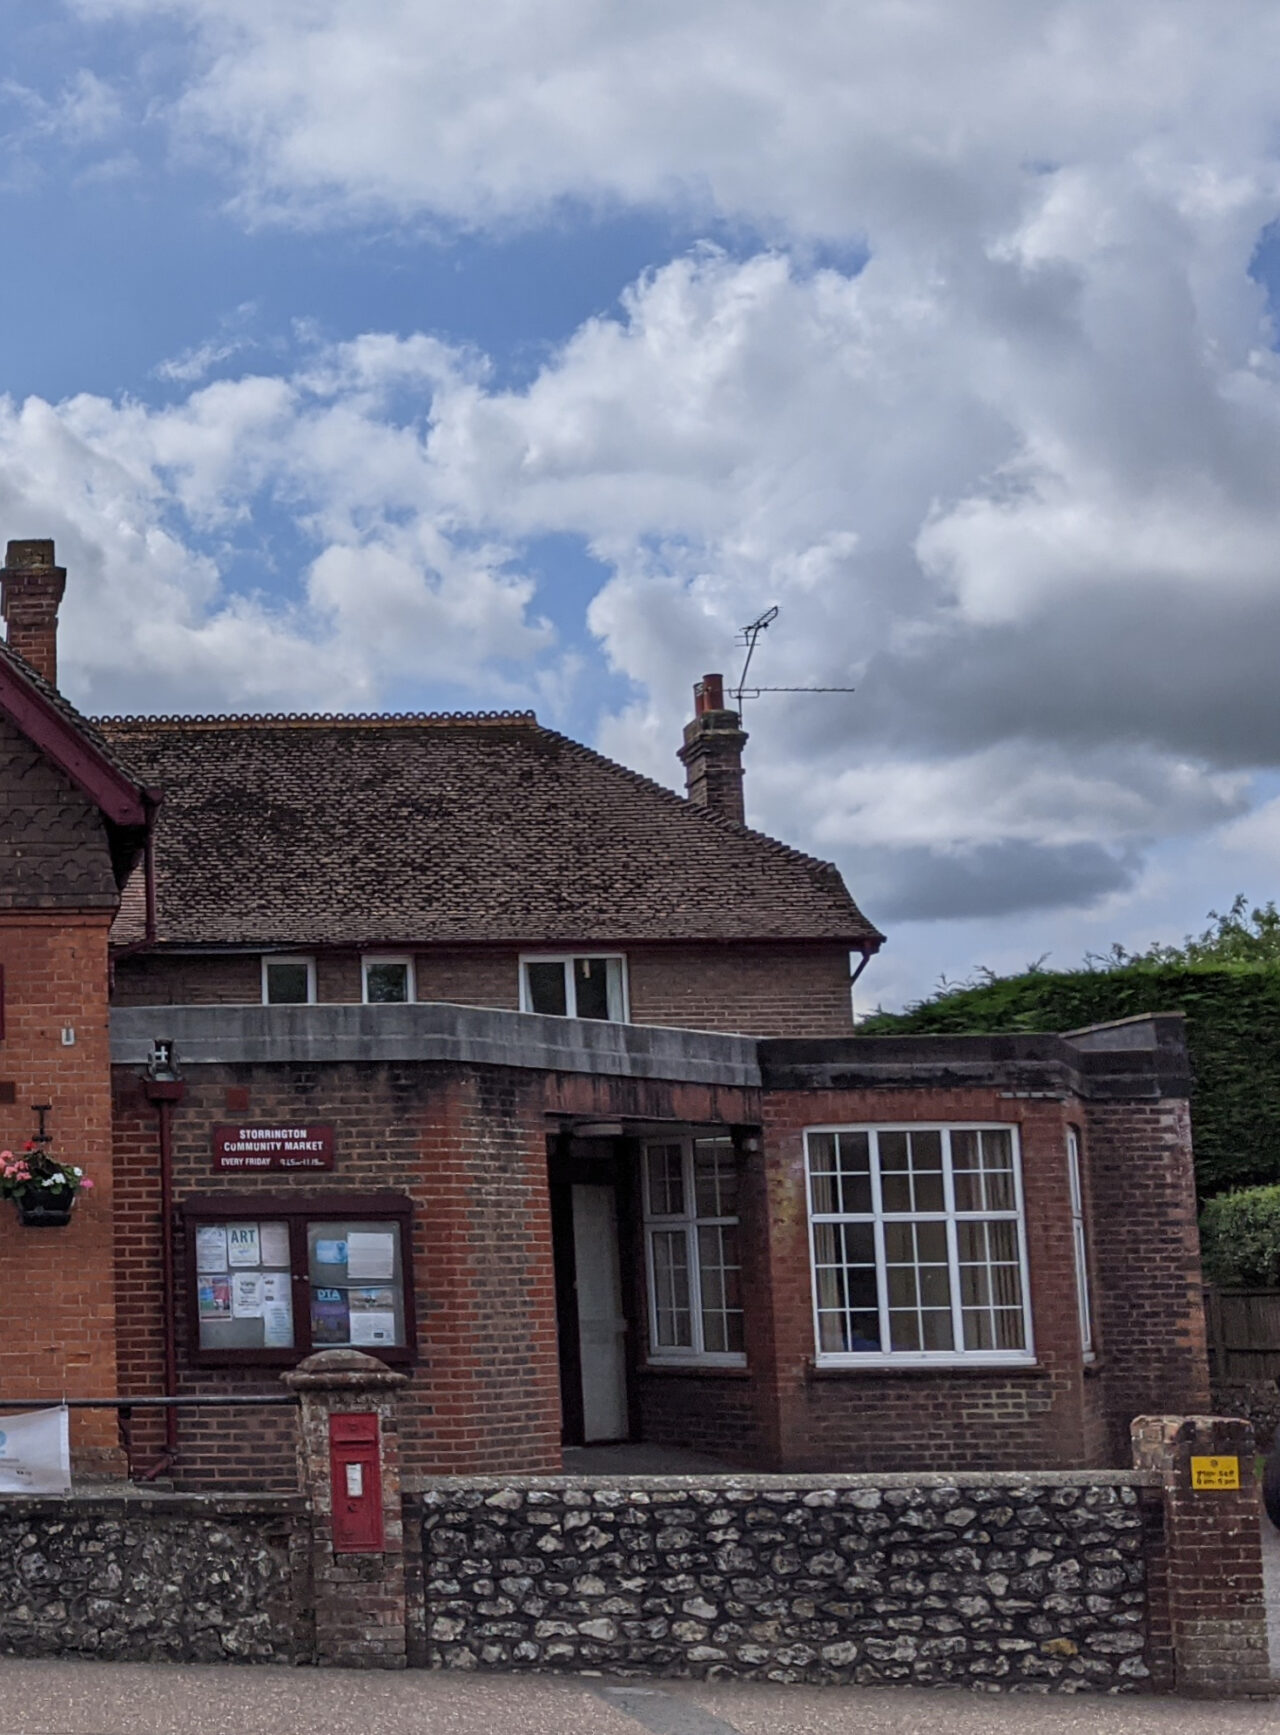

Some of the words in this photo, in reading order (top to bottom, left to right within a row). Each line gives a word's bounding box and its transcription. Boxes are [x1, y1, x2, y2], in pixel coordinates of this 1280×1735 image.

[239, 1129, 307, 1140] STORRINGTON
[223, 1141, 282, 1152] COMMUNITY
[284, 1140, 324, 1151] MARKET
[221, 1157, 244, 1166] EVERY
[245, 1157, 271, 1166] FRIDAY
[231, 1229, 256, 1244] ART
